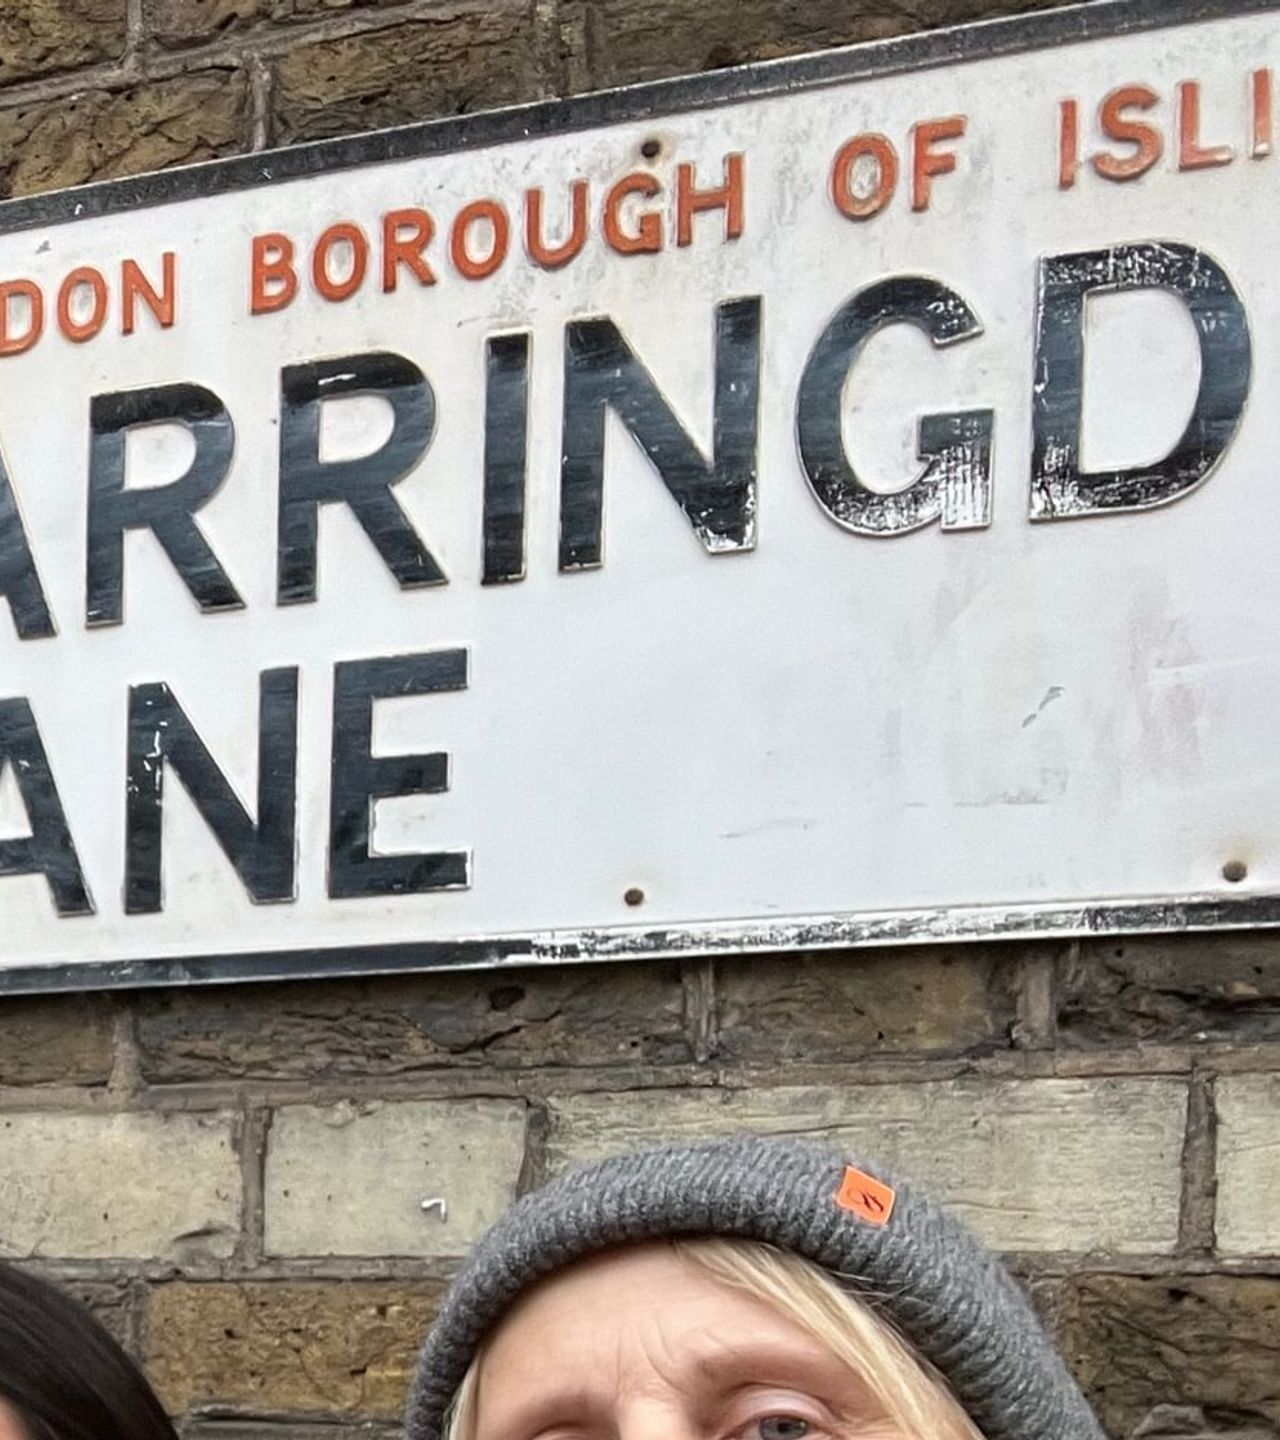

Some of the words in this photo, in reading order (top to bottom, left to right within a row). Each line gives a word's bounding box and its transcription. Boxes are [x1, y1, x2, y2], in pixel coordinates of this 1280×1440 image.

[248, 154, 745, 316] BOROUGH
[830, 118, 966, 216] OF
[1057, 67, 1272, 190] ISLI
